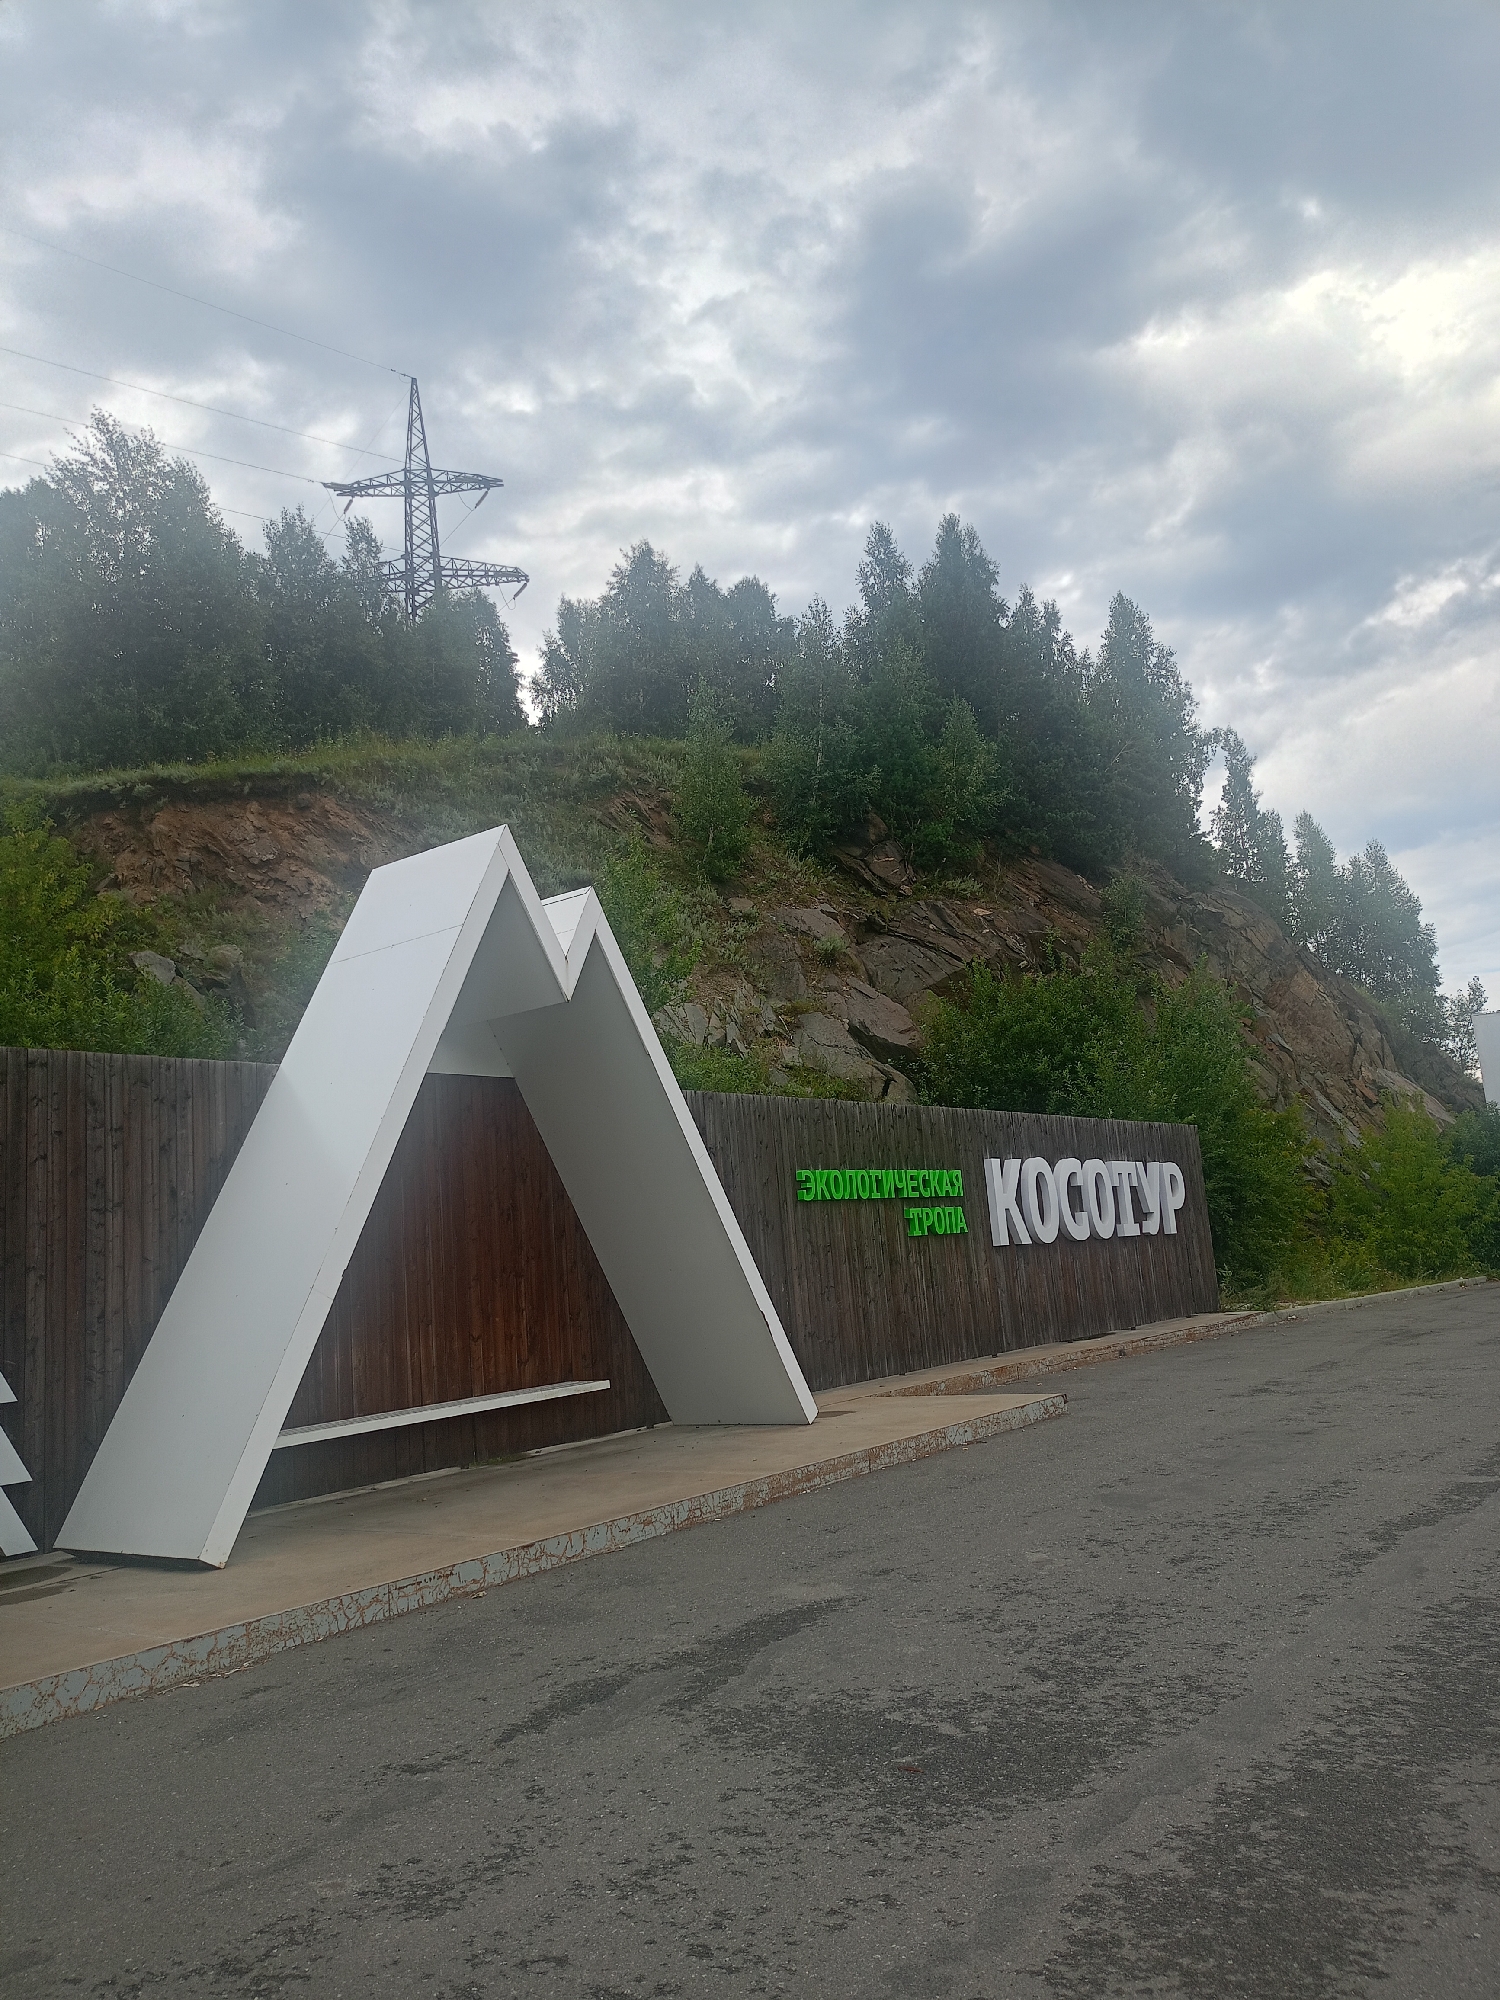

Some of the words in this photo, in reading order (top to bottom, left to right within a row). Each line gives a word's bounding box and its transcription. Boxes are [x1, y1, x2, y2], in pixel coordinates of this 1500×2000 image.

[796, 1169, 964, 1201] ЭКОЛОГИЧЕСКАЯ
[984, 1156, 1186, 1247] КОСОТУР
[904, 1207, 969, 1237] ТРОПА
